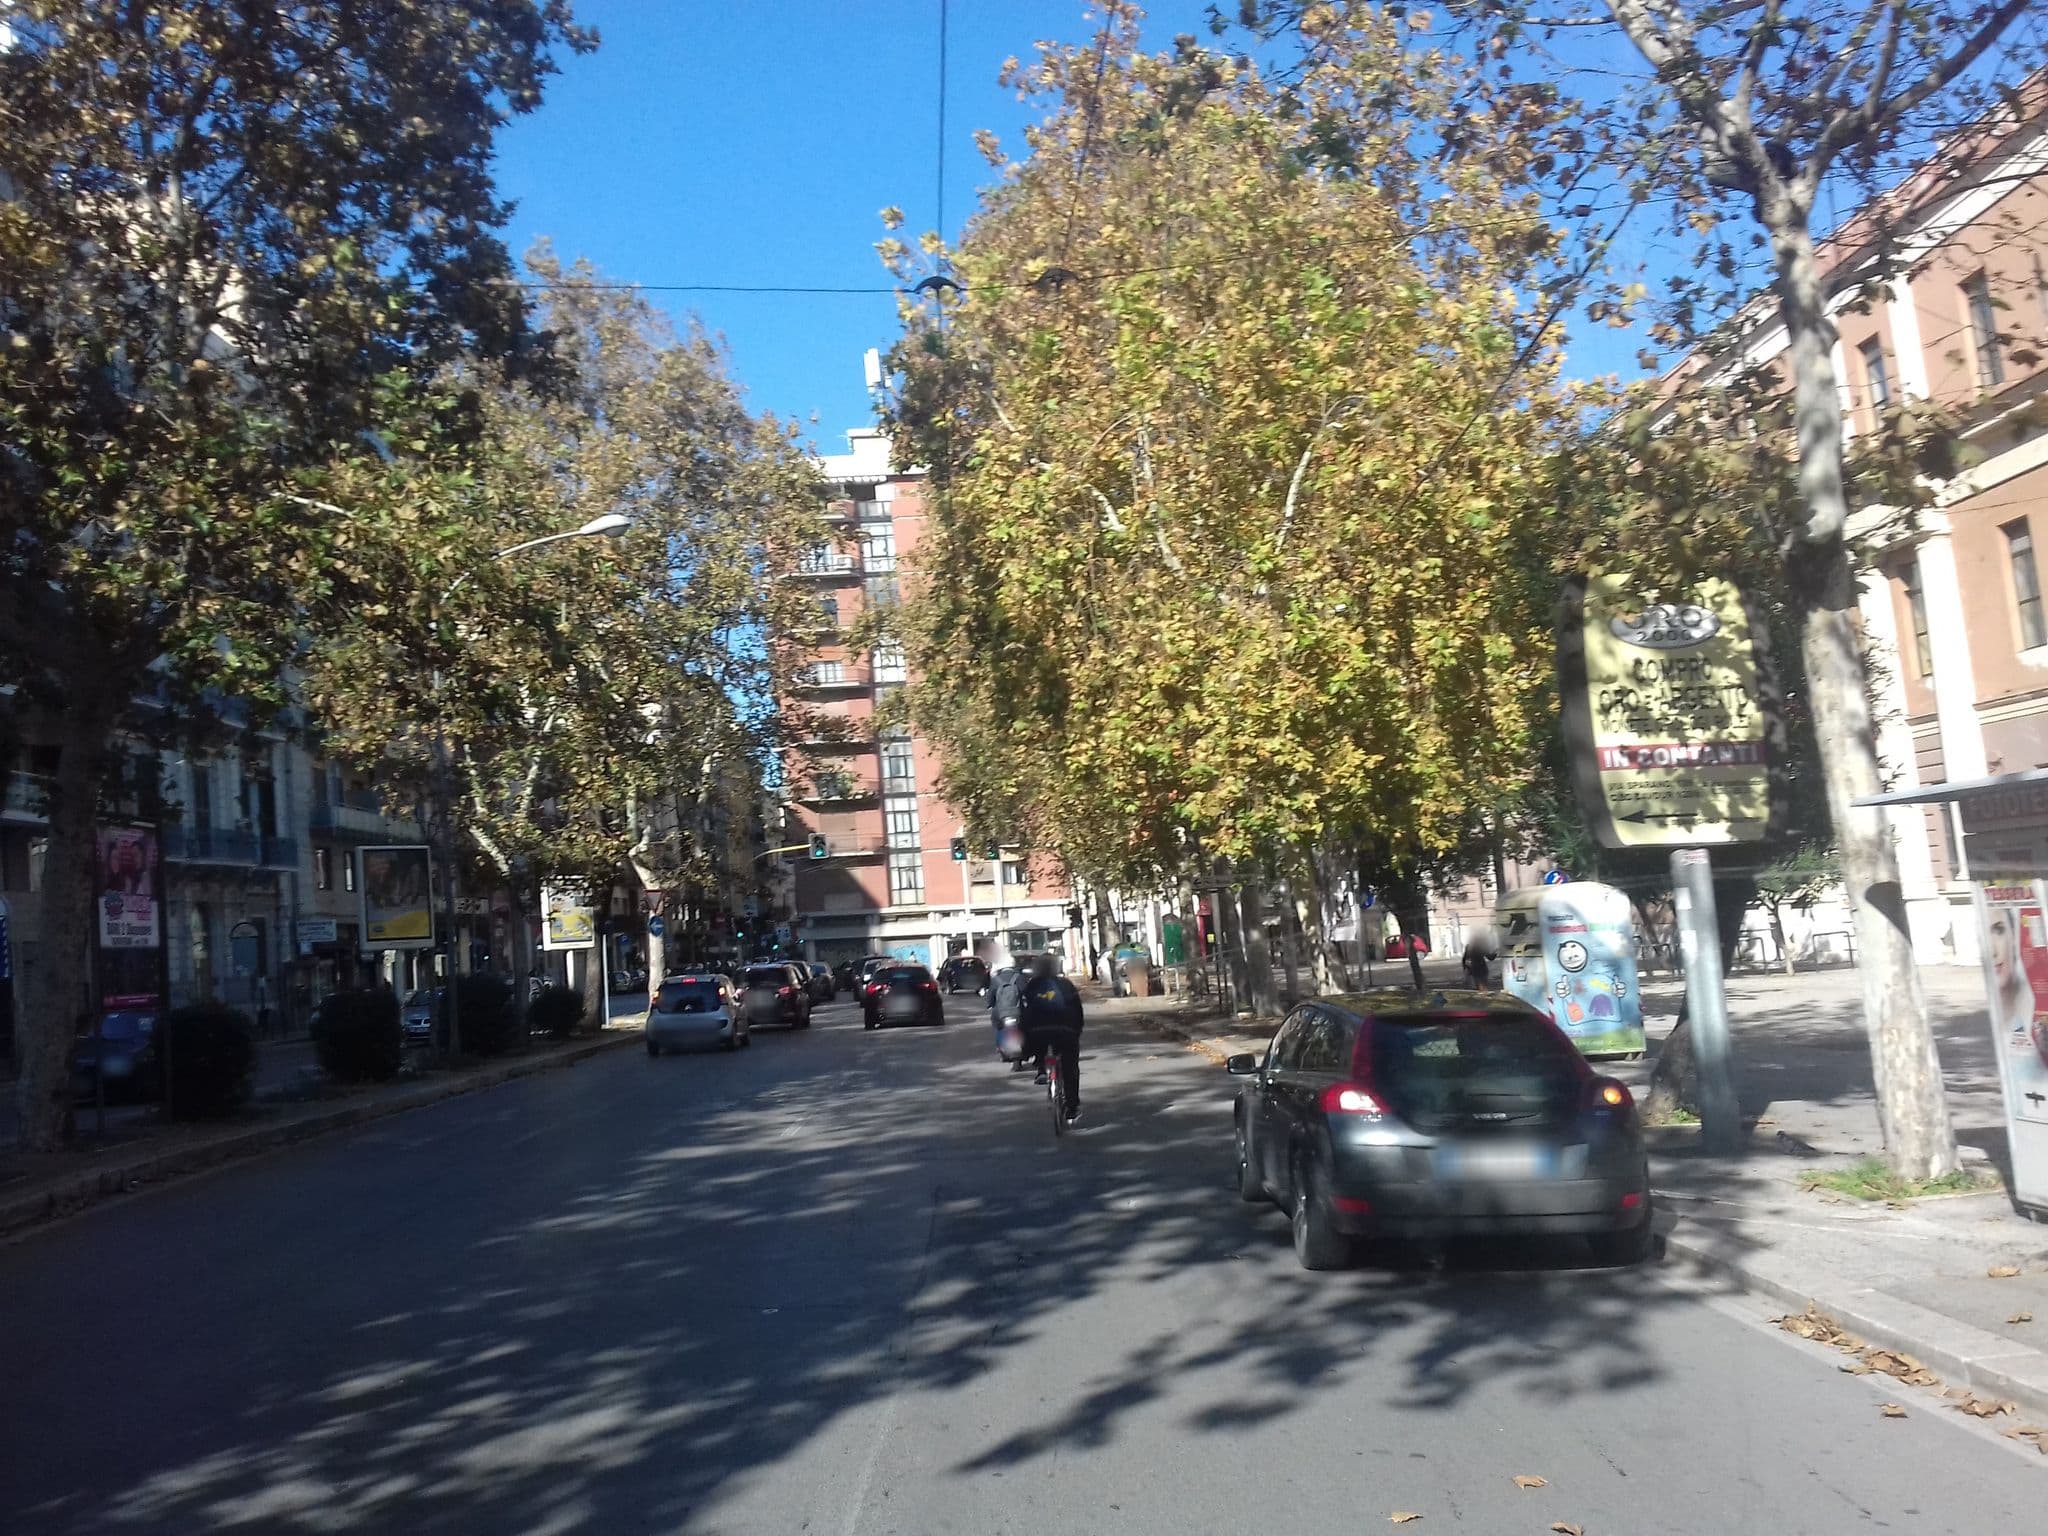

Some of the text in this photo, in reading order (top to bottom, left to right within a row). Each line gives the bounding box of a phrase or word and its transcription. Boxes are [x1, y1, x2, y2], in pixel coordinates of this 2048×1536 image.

[1633, 656, 1712, 682] COMPRO
[1603, 743, 1759, 768] IN CONTANTI
